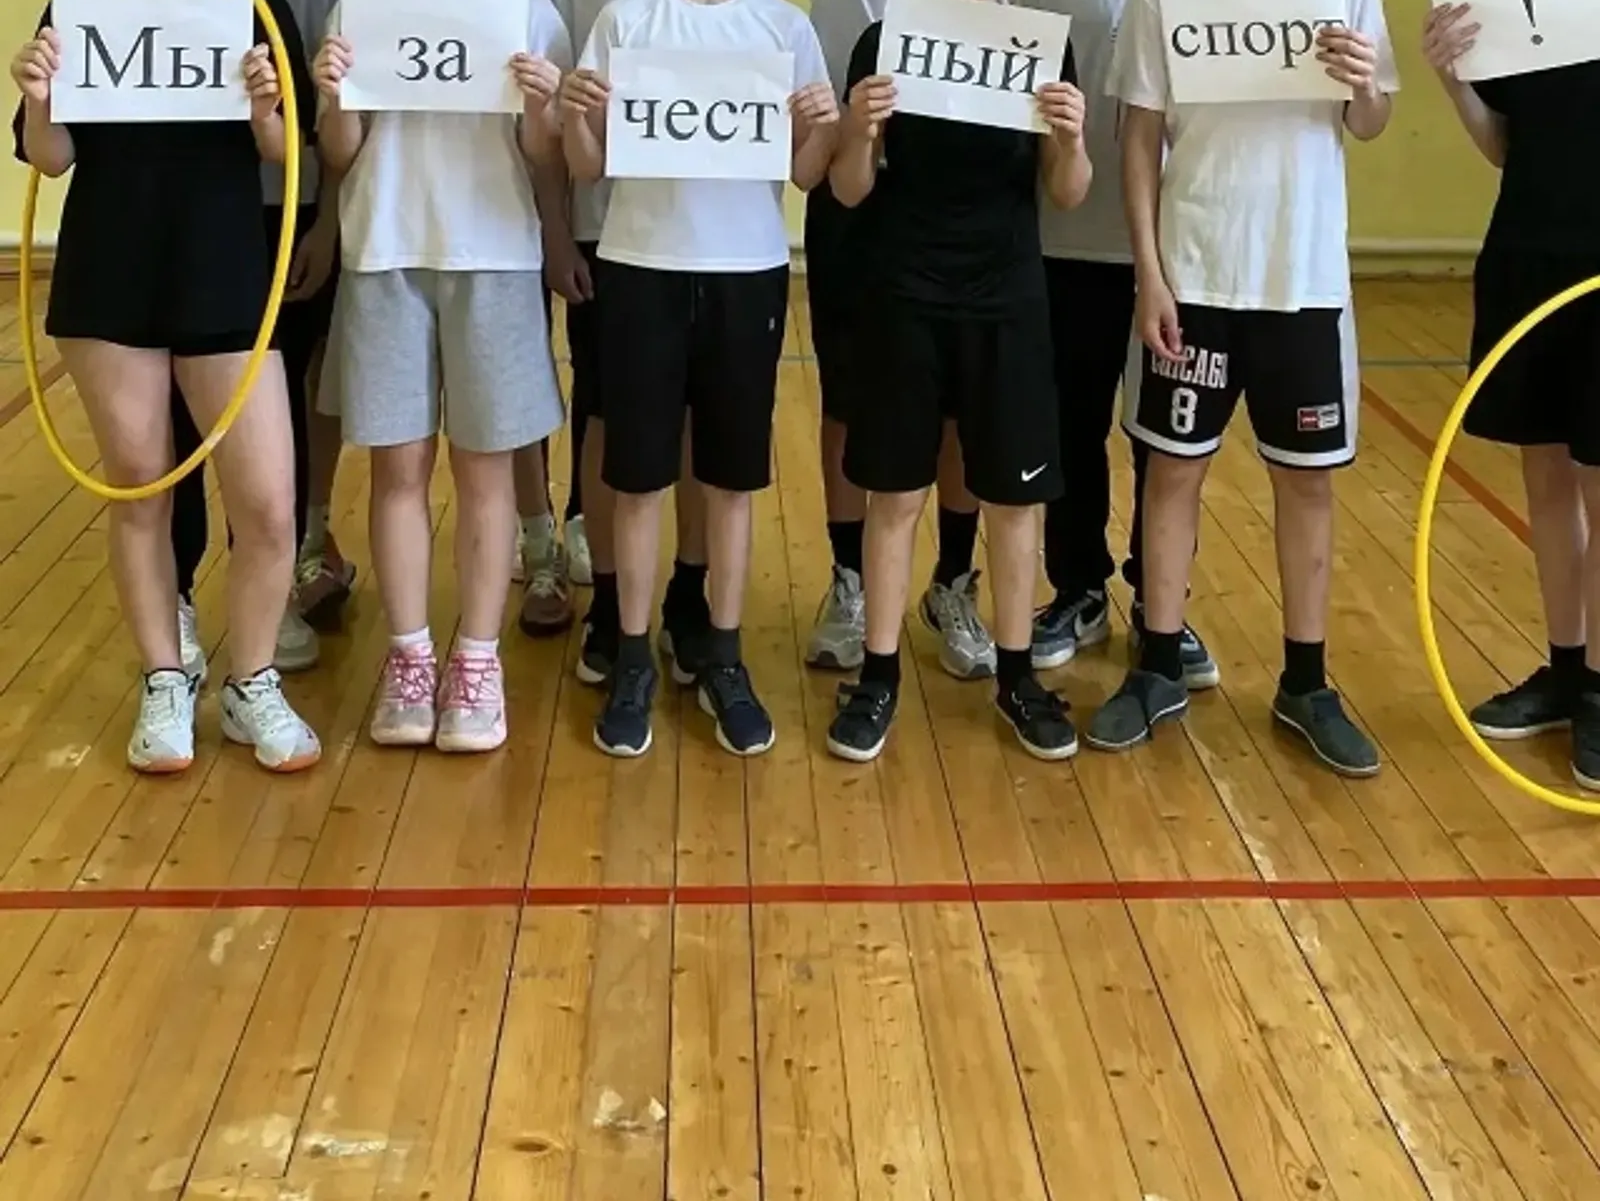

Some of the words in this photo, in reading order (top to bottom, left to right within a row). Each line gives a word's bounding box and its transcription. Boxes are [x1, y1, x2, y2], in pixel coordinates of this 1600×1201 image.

[76, 24, 229, 89] Мы
[396, 36, 472, 82] за
[894, 34, 1044, 95] ный
[1171, 18, 1346, 70] спор
[623, 98, 780, 143] чест
[1170, 386, 1199, 435] 8
